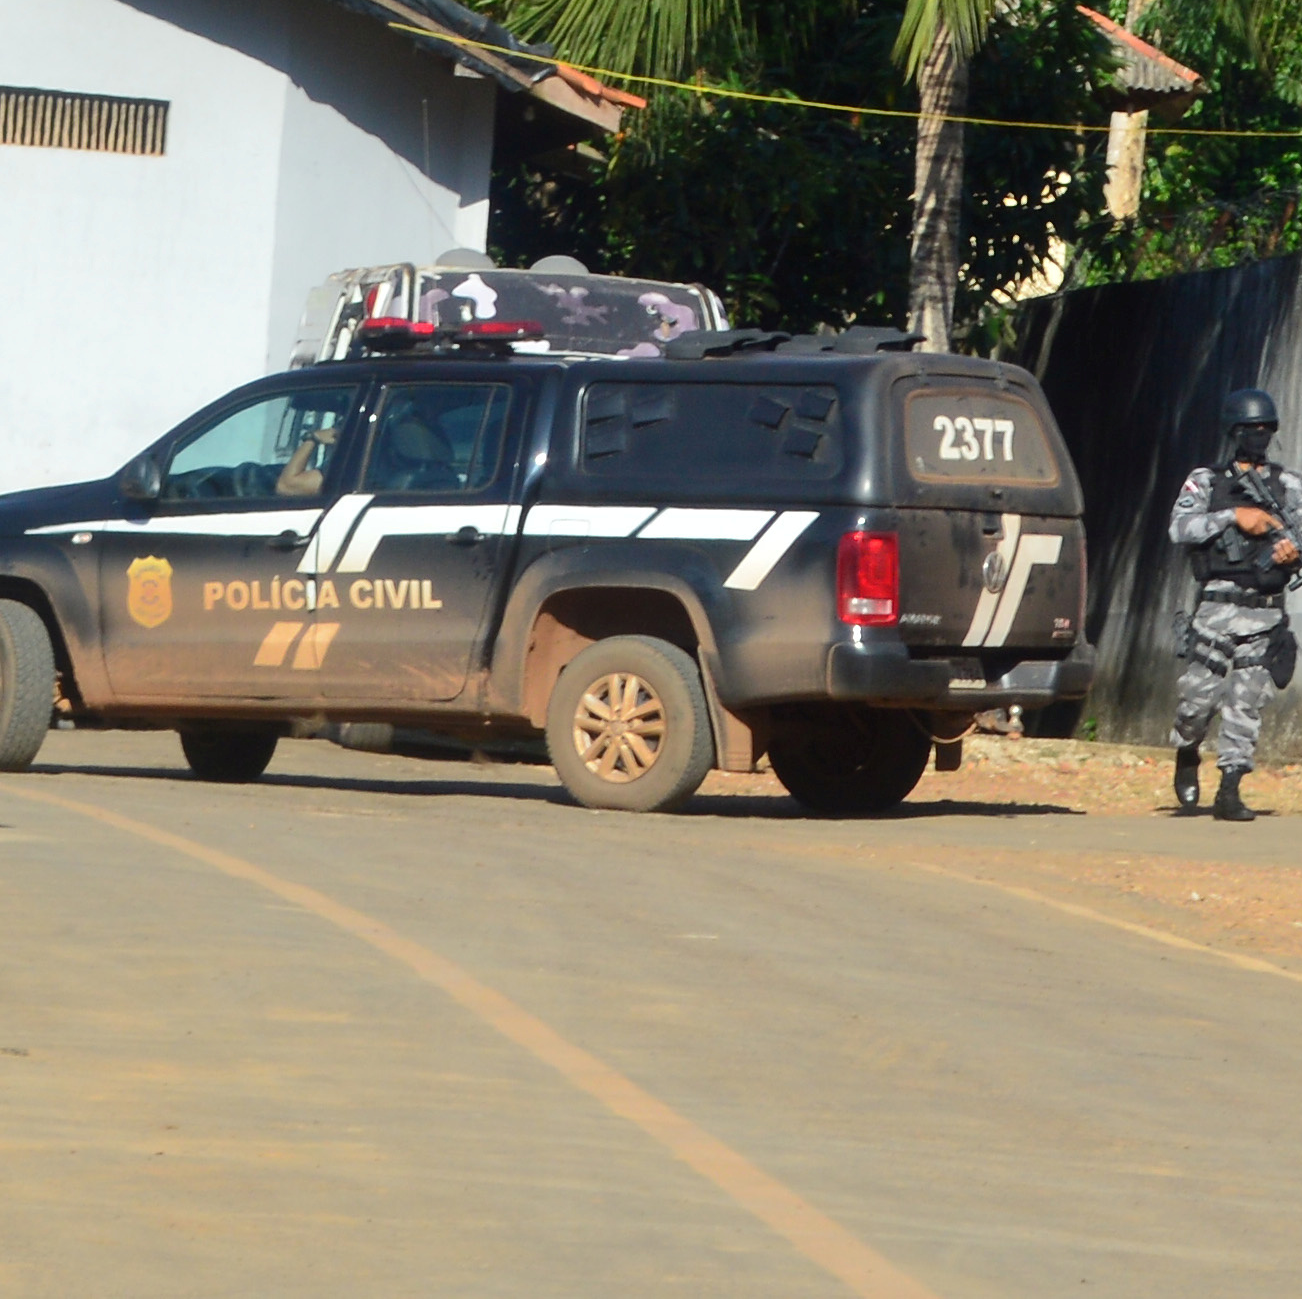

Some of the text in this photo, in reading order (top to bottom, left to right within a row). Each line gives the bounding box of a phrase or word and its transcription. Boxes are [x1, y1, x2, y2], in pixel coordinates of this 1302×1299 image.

[933, 415, 1015, 461] 2377
[203, 575, 443, 610] POLÍCIA CIVIL
